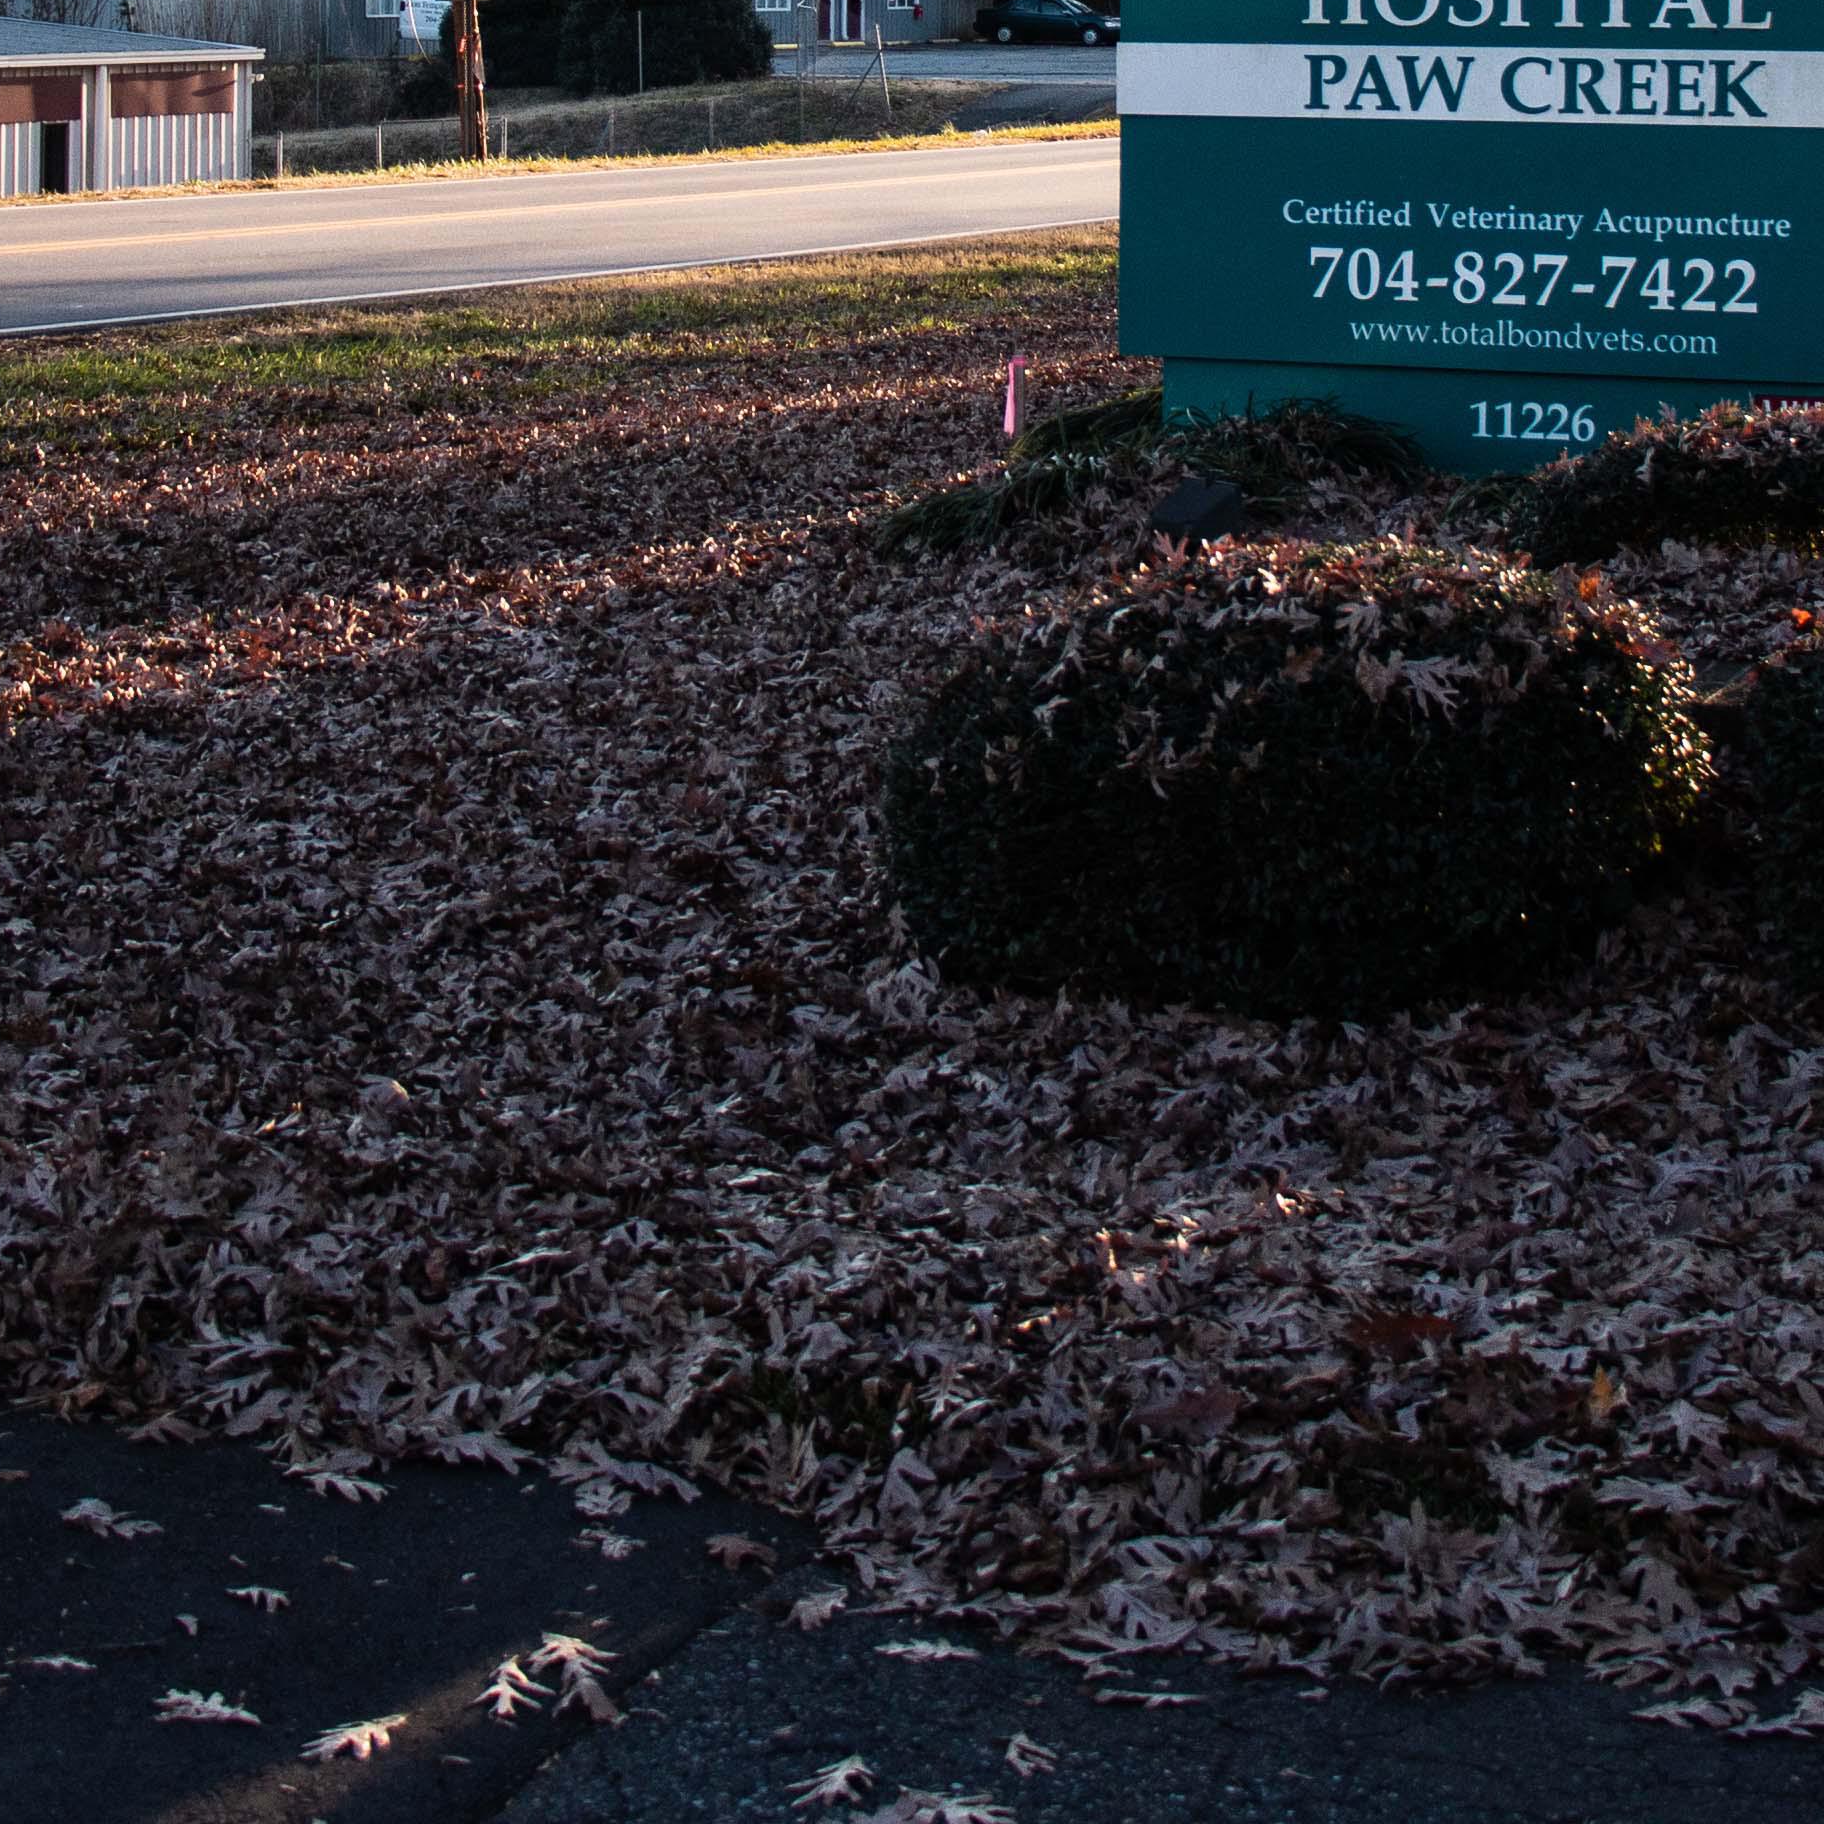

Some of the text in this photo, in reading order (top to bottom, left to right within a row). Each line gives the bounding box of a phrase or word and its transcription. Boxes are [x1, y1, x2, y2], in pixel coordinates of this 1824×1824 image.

[1303, 54, 1768, 118] PAW CREEK
[1282, 198, 1791, 242] Certified Veterinary Acupuncture
[1309, 246, 1759, 314] 704-827-7422
[1350, 319, 1718, 355] www.totalbondvets.com
[1469, 401, 1596, 442] 11226
